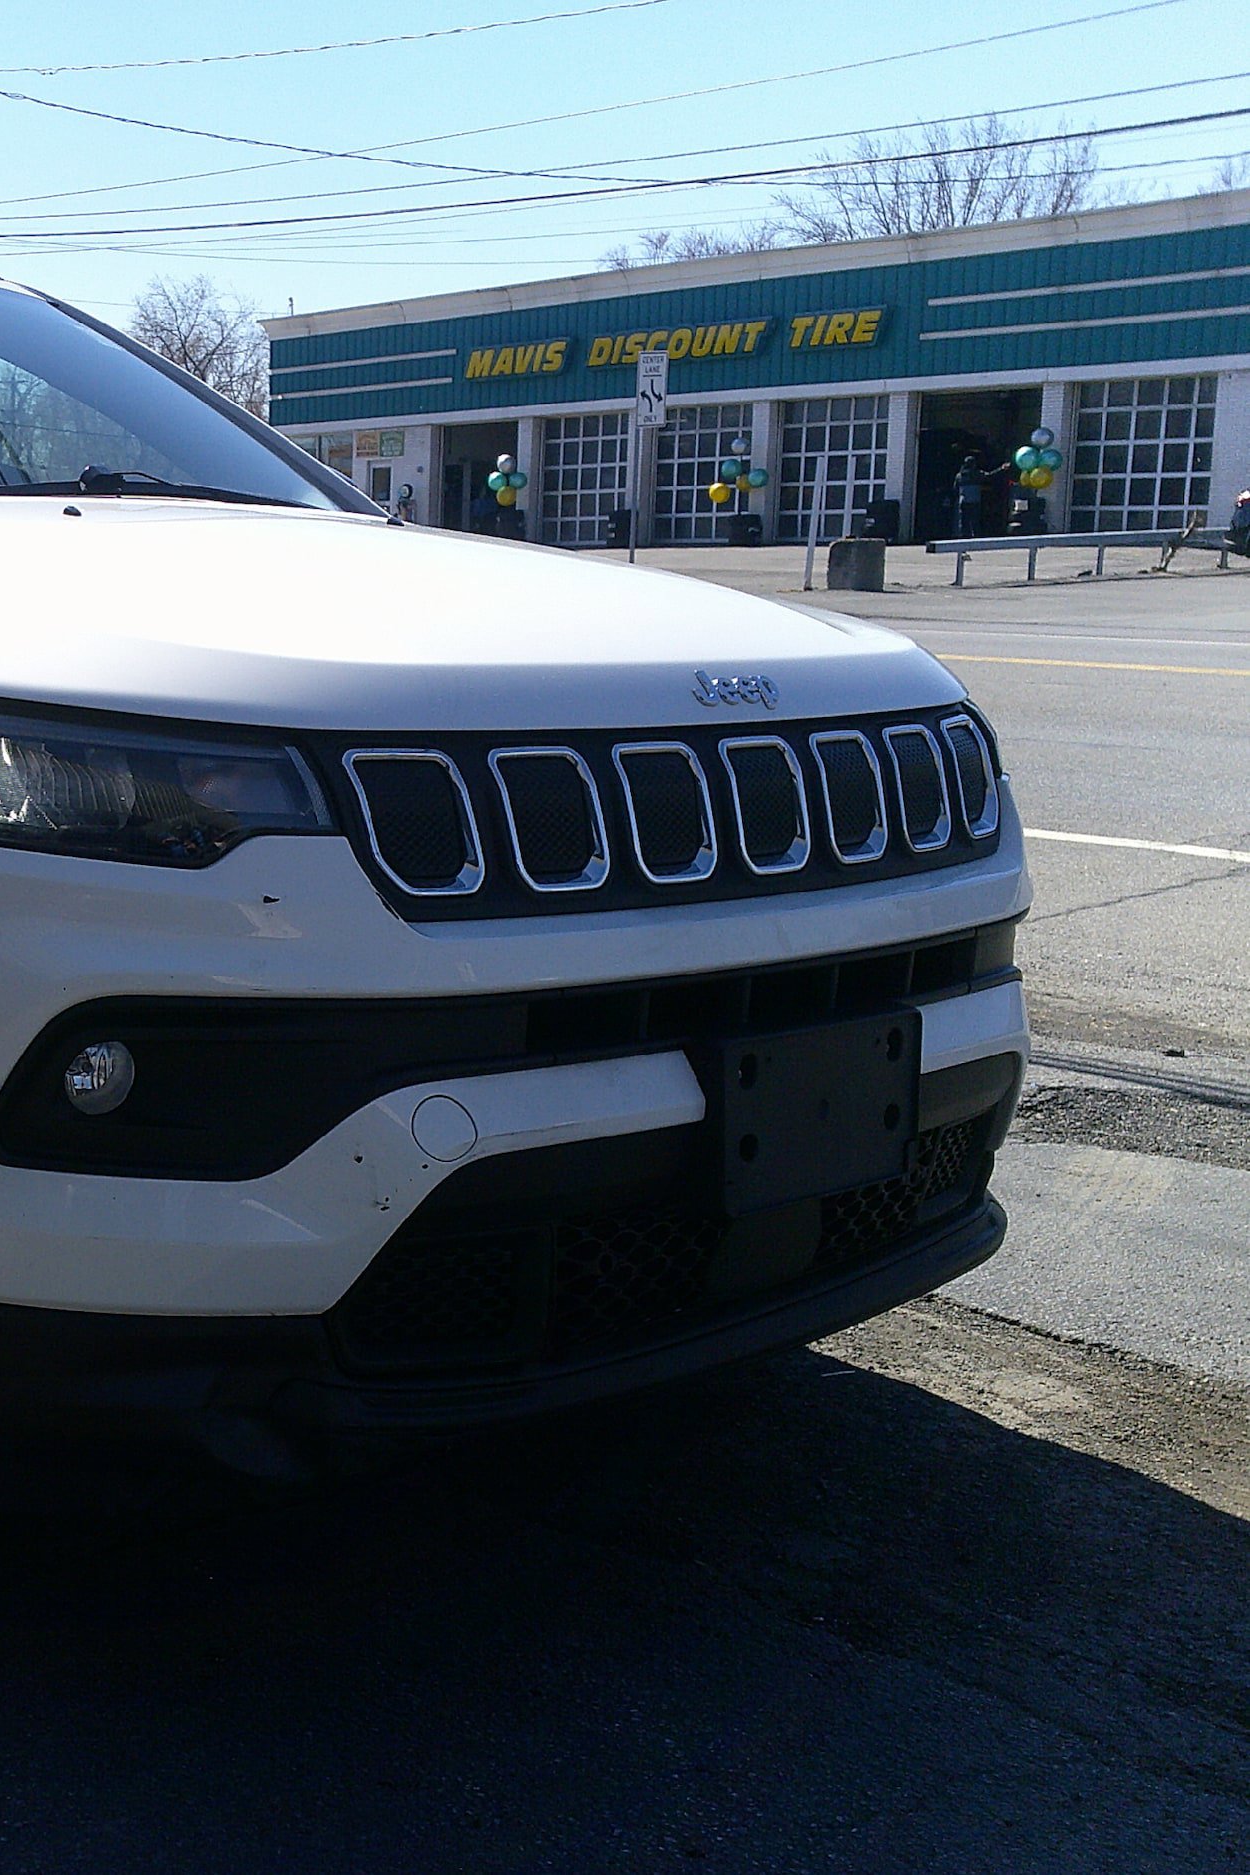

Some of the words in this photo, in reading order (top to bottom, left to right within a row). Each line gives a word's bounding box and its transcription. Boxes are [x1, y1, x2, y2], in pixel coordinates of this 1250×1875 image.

[466, 341, 567, 378] MAVIS
[586, 322, 766, 367] DISCOUNT
[790, 310, 882, 347] TIRE
[642, 355, 665, 364] CENTER
[644, 415, 657, 423] ONLY
[692, 669, 780, 711] Jeep
